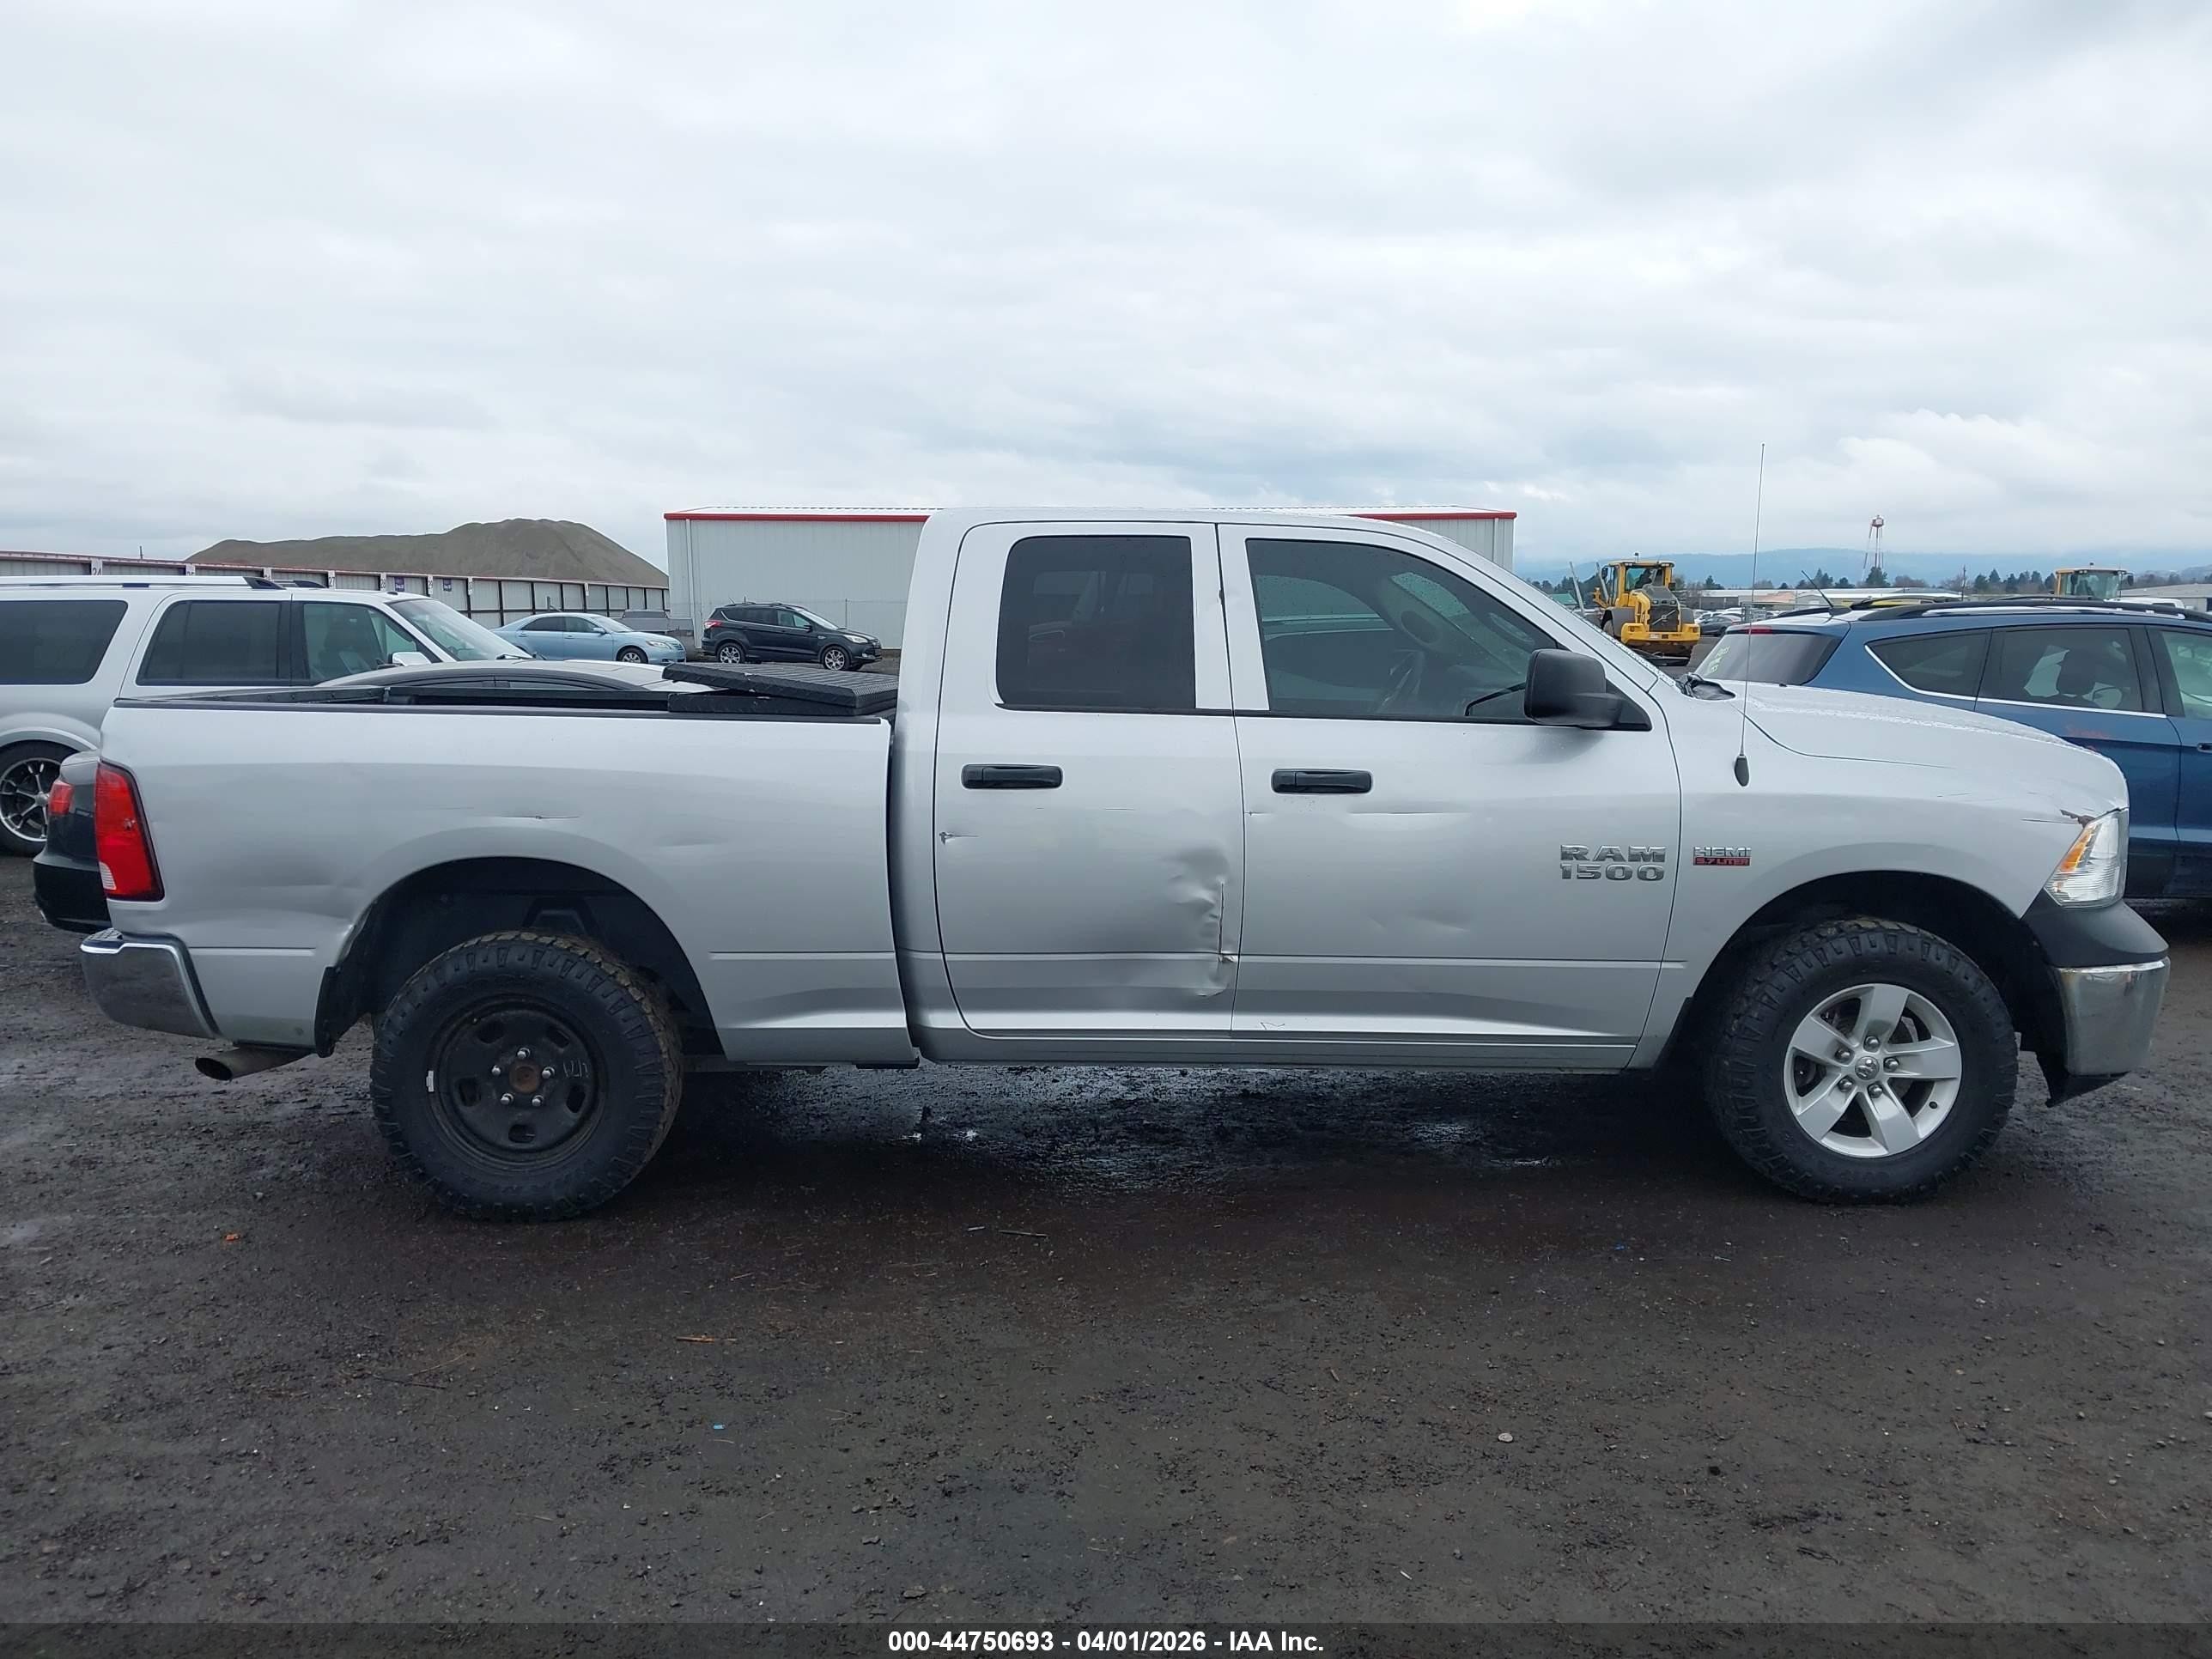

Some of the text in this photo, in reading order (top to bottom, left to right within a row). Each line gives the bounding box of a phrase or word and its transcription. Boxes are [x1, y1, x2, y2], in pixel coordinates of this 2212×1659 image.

[329, 577, 336, 586] 27
[1560, 845, 1667, 862] RAM
[1693, 846, 1752, 857] HEMI
[1560, 864, 1665, 881] 1500
